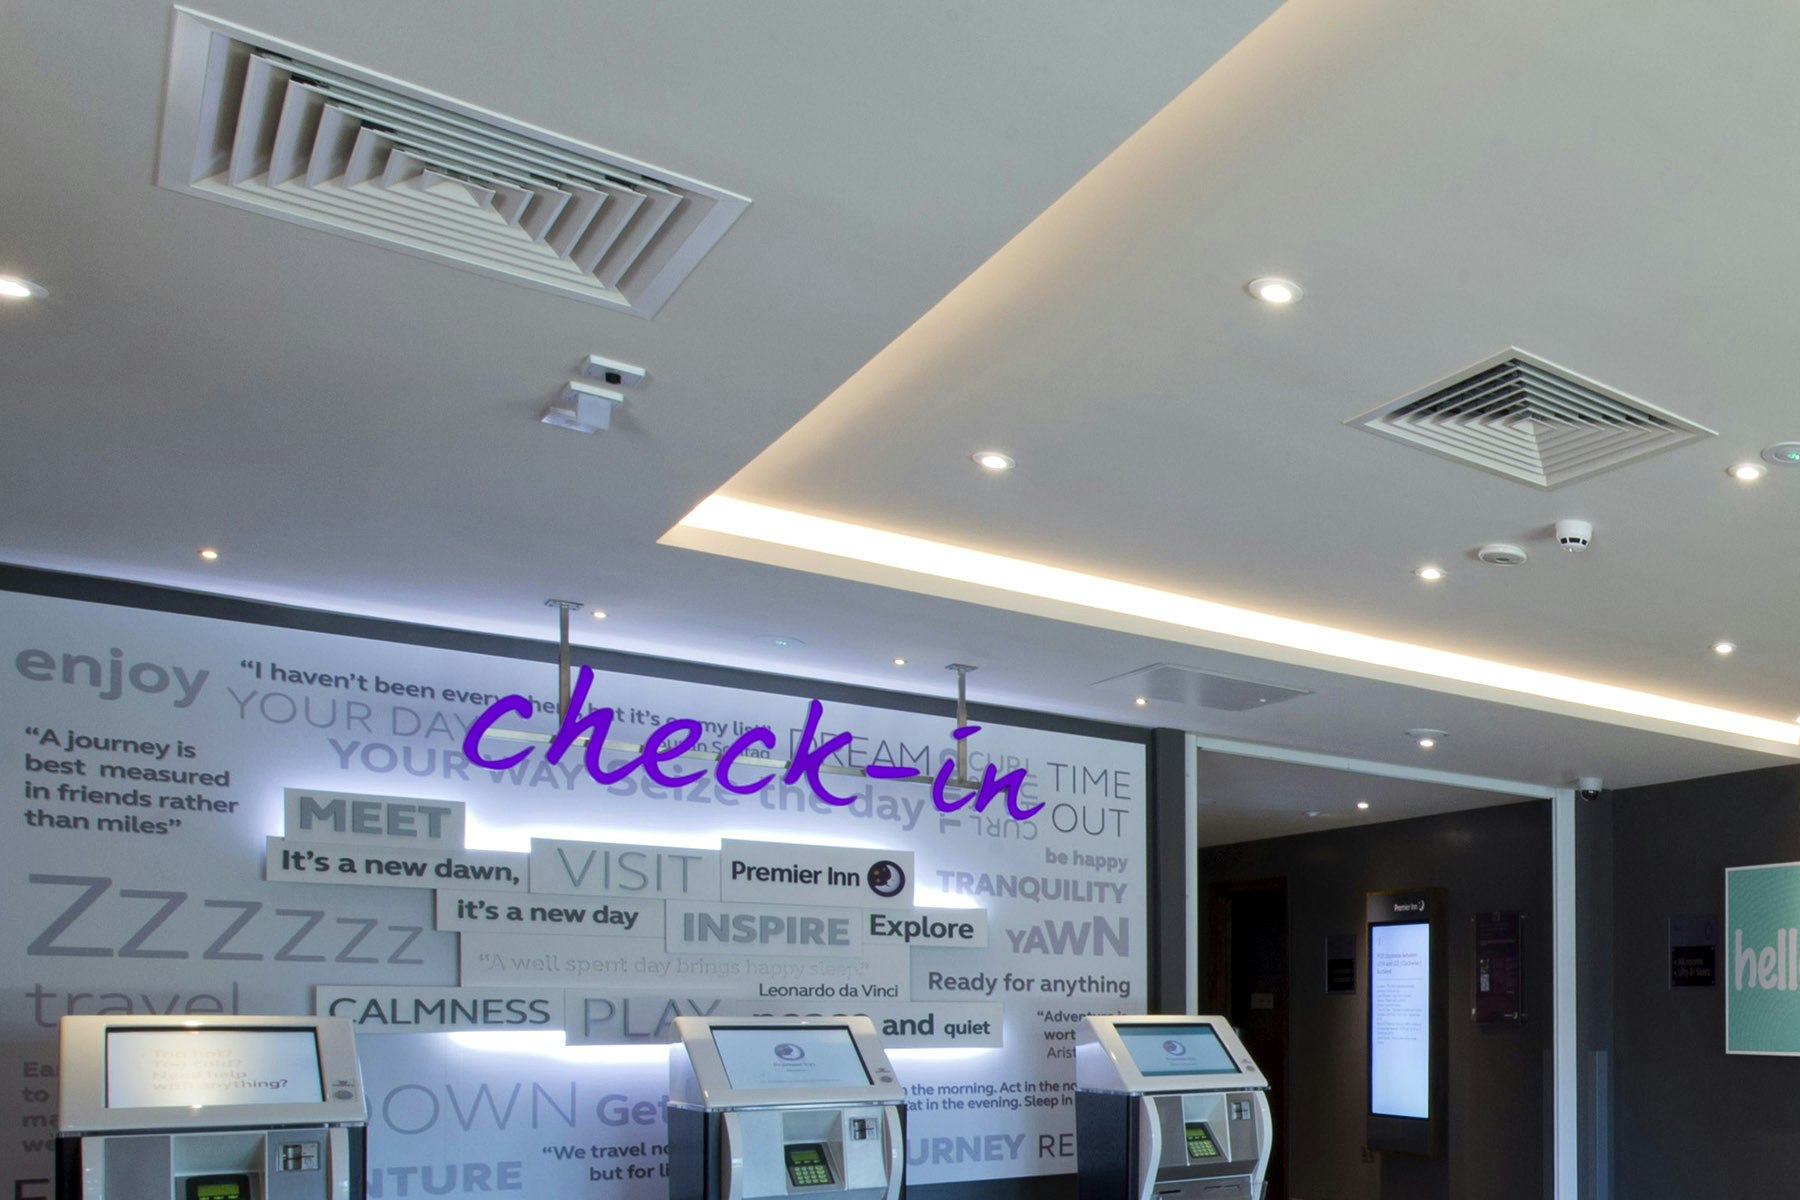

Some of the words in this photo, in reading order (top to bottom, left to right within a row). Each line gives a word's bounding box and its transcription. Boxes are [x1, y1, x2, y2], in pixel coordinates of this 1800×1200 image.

[15, 647, 210, 708] enjoy
[227, 687, 373, 733] YOUR
[392, 706, 476, 742] DAY
[375, 676, 435, 699] been
[701, 720, 728, 737] my
[64, 730, 171, 760] journey
[177, 740, 197, 759] is
[462, 664, 1046, 823] check-in
[25, 753, 86, 775] best
[100, 764, 230, 787] measured
[327, 737, 470, 781] YOUR
[483, 753, 585, 791] WAY
[849, 783, 926, 831] day
[1047, 762, 1133, 800] TIME
[25, 781, 50, 800] in
[57, 784, 152, 808] friends
[159, 794, 239, 814] rather
[24, 809, 90, 830] than
[300, 796, 452, 838] MEET
[1052, 803, 1130, 838] OUT
[338, 857, 357, 873] a
[365, 858, 427, 877] new
[434, 858, 520, 885] dawn,
[557, 847, 702, 893] VISIT
[731, 861, 823, 885] Premier
[828, 867, 860, 887] Inn
[1045, 848, 1069, 864] be
[1073, 850, 1129, 874] happy
[935, 869, 1129, 904] TRANQUILITY
[506, 905, 524, 921] a
[530, 906, 586, 923] new
[592, 905, 639, 930] day
[683, 912, 850, 946] INSPIRE
[869, 913, 975, 943] Explore
[1006, 916, 1130, 957] YAWN
[511, 955, 560, 972] well
[565, 957, 628, 977] spent
[634, 957, 671, 977] day
[676, 959, 741, 977] brings
[746, 960, 806, 980] happy
[759, 983, 834, 998] Leonardo
[838, 984, 858, 998] da
[861, 984, 899, 998] Vinci
[928, 971, 998, 996] Ready
[1003, 973, 1035, 992] for
[1040, 975, 1131, 998] anything
[329, 997, 551, 1025] CALMNESS
[882, 1013, 934, 1036] and
[944, 1020, 990, 1038] quiet
[912, 1083, 934, 1096] the
[938, 1082, 997, 1100] morning.
[1000, 1081, 1022, 1094] Act
[1025, 1079, 1036, 1092] in
[1039, 1078, 1059, 1092] the
[926, 1098, 938, 1110] in
[942, 1097, 964, 1110] the
[968, 1097, 1022, 1111] evening.
[1025, 1095, 1058, 1109] Sleep
[1061, 1094, 1073, 1106] in
[366, 1081, 576, 1135] OWN
[592, 1143, 647, 1158] travel
[590, 1168, 623, 1181] but
[627, 1166, 655, 1179] for
